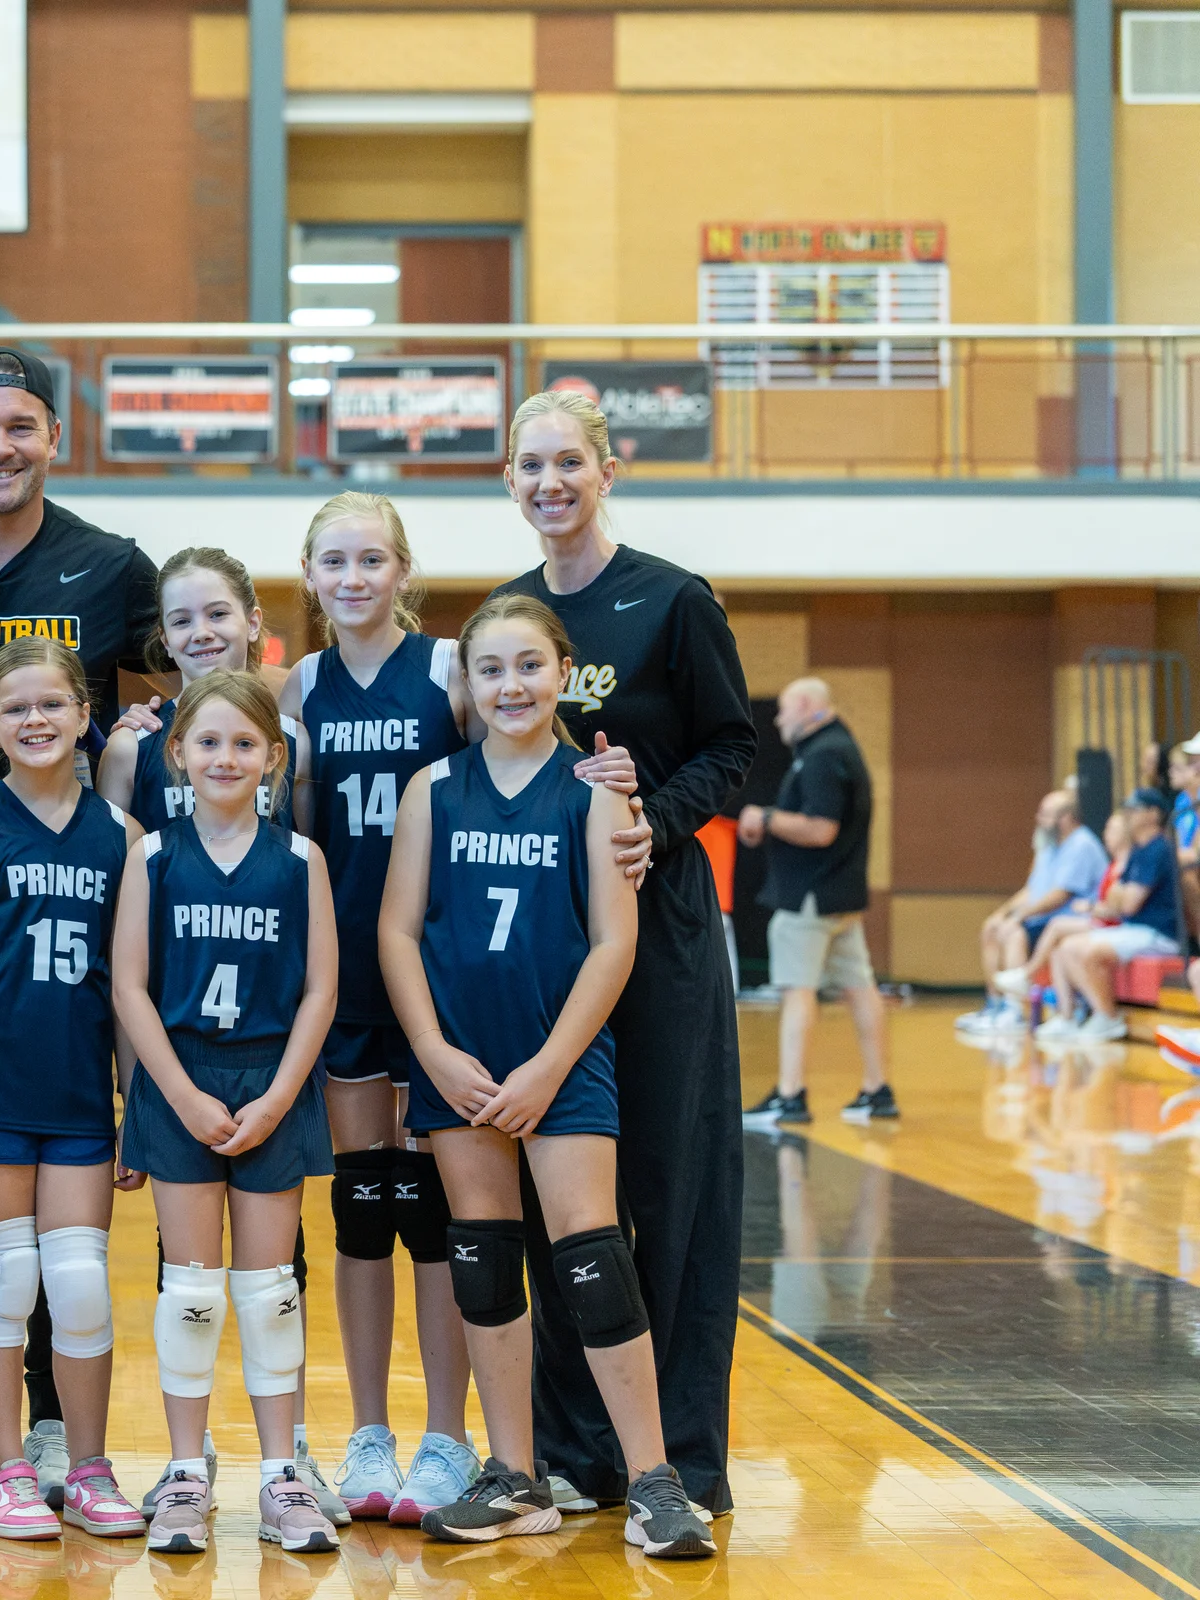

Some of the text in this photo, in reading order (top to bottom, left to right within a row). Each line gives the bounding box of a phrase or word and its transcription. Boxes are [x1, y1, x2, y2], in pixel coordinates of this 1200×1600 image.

[566, 664, 617, 699] nce
[319, 718, 420, 753] PRINCE
[164, 785, 270, 818] PRE
[337, 773, 397, 837] 14
[451, 831, 559, 868] PRINCE
[7, 863, 107, 904] PRINCE
[173, 905, 280, 942] PRINCE
[487, 887, 520, 951] 7
[26, 918, 88, 985] 15
[201, 964, 241, 1029] 4
